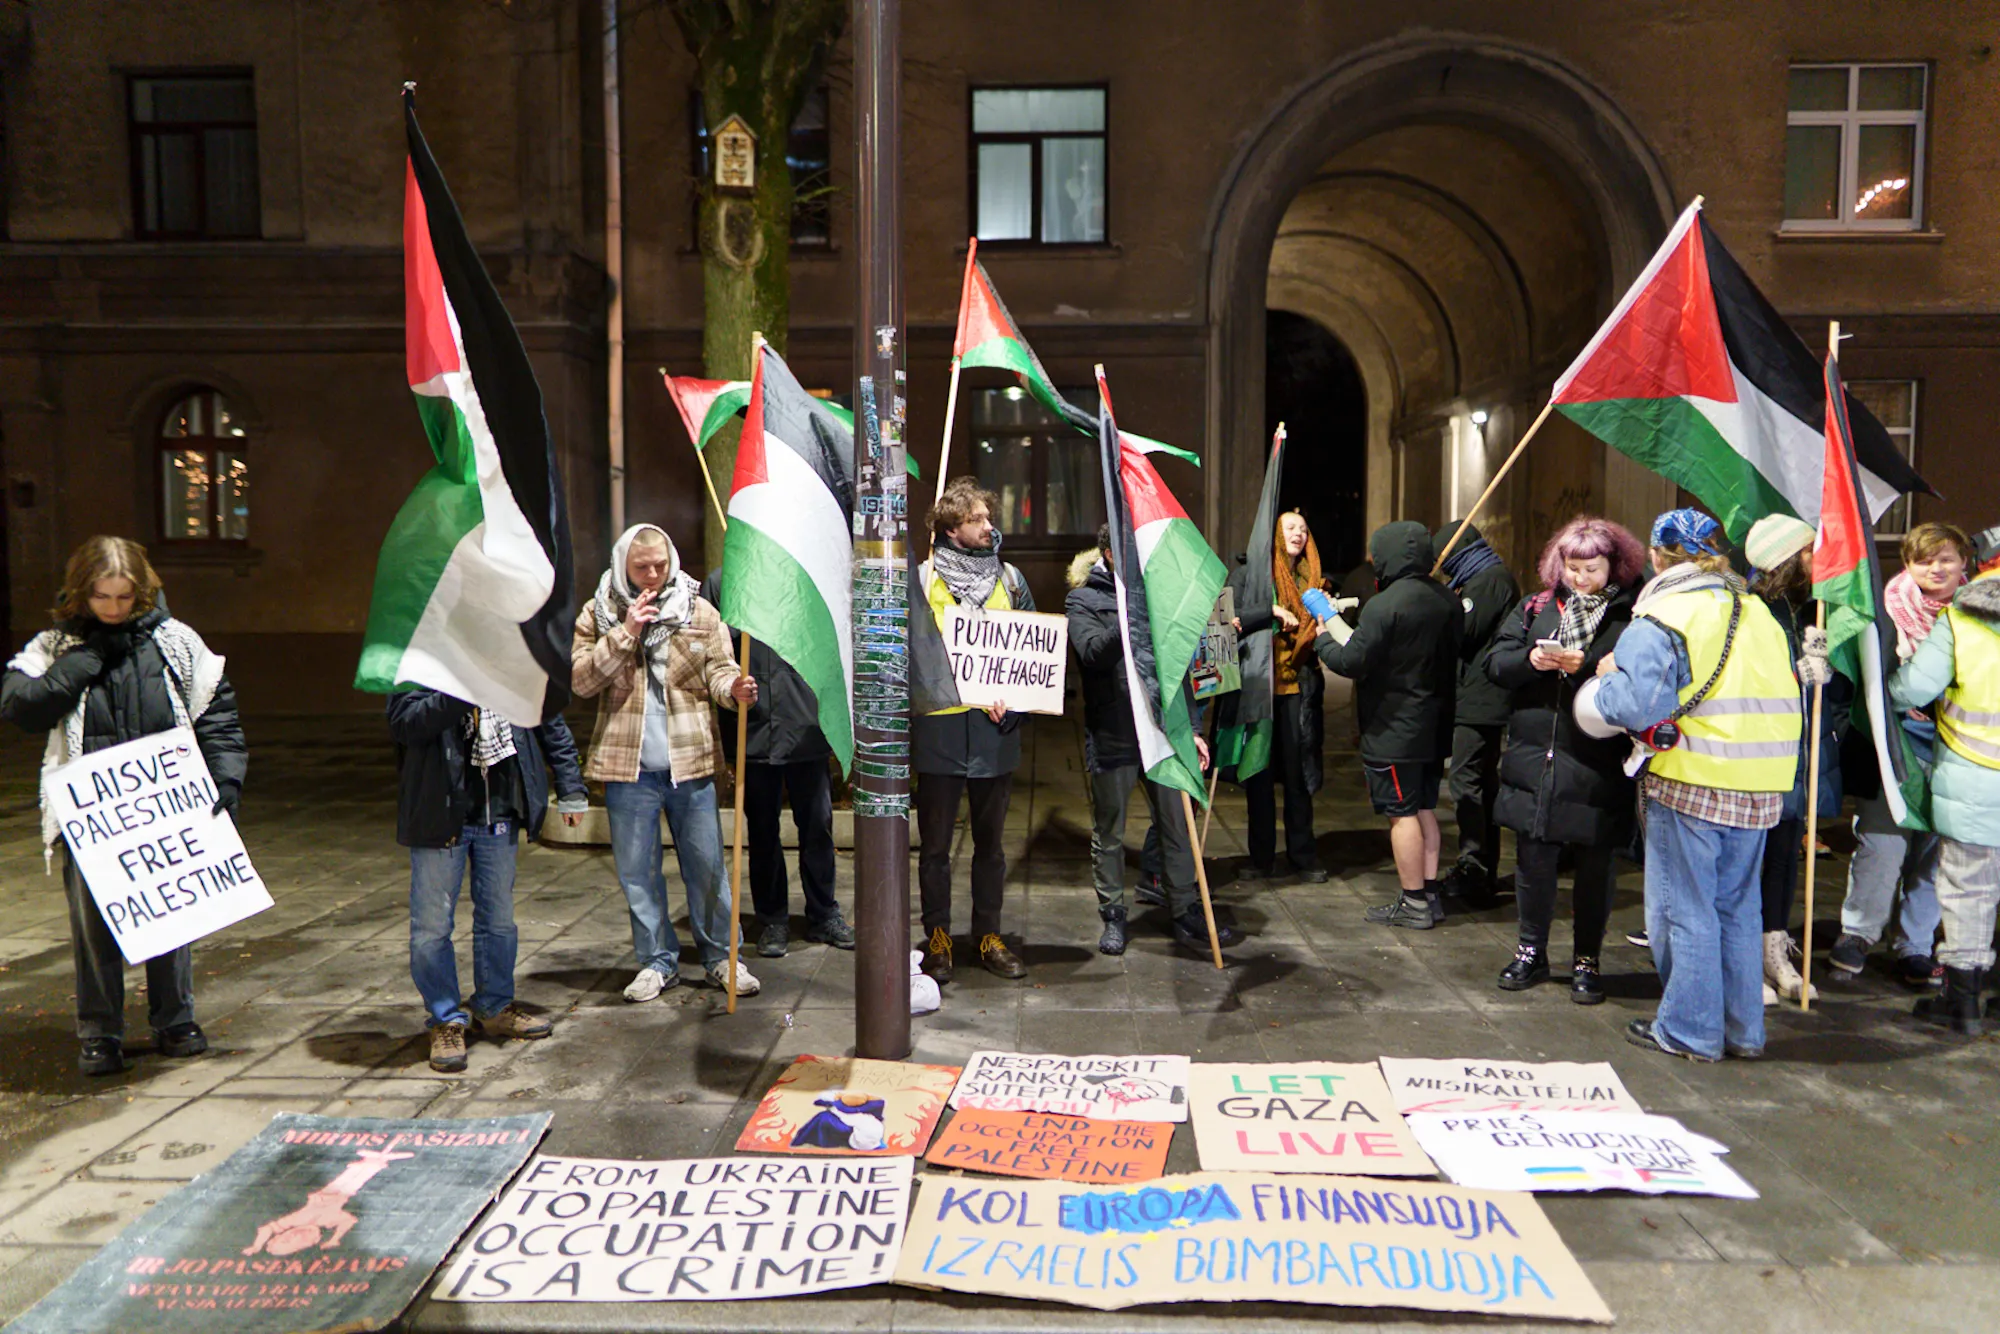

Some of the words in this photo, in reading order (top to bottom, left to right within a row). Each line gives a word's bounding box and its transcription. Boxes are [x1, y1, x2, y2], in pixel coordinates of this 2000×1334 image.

[954, 617, 1057, 653] PUTINYAHU
[1200, 633, 1239, 673] ESTINE
[952, 653, 974, 681] TO
[979, 655, 1009, 685] THE
[1008, 659, 1058, 688] HAGUE
[67, 746, 180, 810] LAISVĖ
[118, 827, 205, 882] FREE
[106, 852, 254, 935] PALESTINE
[979, 1057, 1168, 1073] NESPAUSKIT
[1463, 1066, 1534, 1081] KARO
[1231, 1074, 1345, 1096] LET
[1217, 1097, 1380, 1123] GAZA
[279, 1129, 388, 1147] MIRTIS
[959, 1122, 1155, 1149] OCCUPATION
[1024, 1116, 1090, 1131] END
[1114, 1124, 1157, 1138] THE
[1009, 1140, 1089, 1158] FREE
[1236, 1130, 1404, 1157] LIVE
[526, 1161, 659, 1186] FROM
[944, 1143, 1143, 1178] PALESTINE
[937, 1187, 1042, 1228] KOL
[1058, 1184, 1242, 1231] EUROPA
[1251, 1183, 1521, 1240] FINANSUOJA
[532, 1261, 581, 1296] A
[922, 1235, 1142, 1289] IZRAELIS
[1174, 1237, 1556, 1304] BOMBARDUOJA
